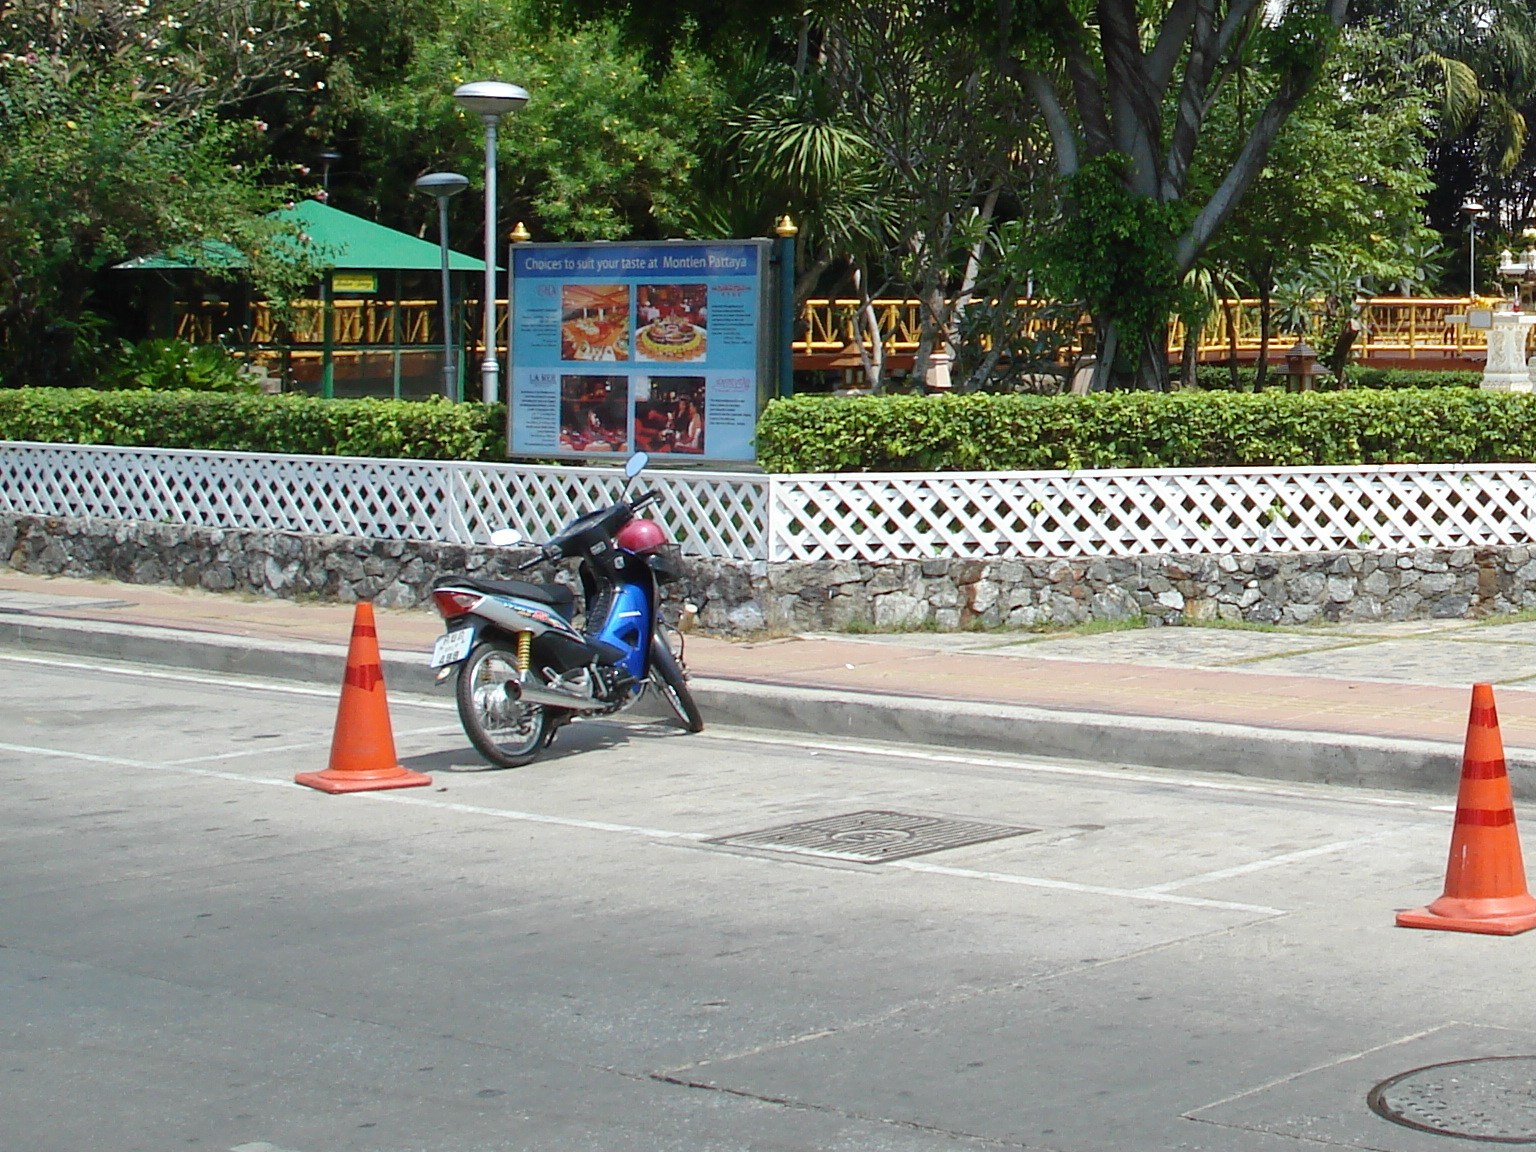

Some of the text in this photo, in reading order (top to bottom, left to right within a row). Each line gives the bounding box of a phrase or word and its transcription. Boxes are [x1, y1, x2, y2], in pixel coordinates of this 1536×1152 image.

[525, 255, 747, 272] Choices to suit your taste at Montien Pattaya
